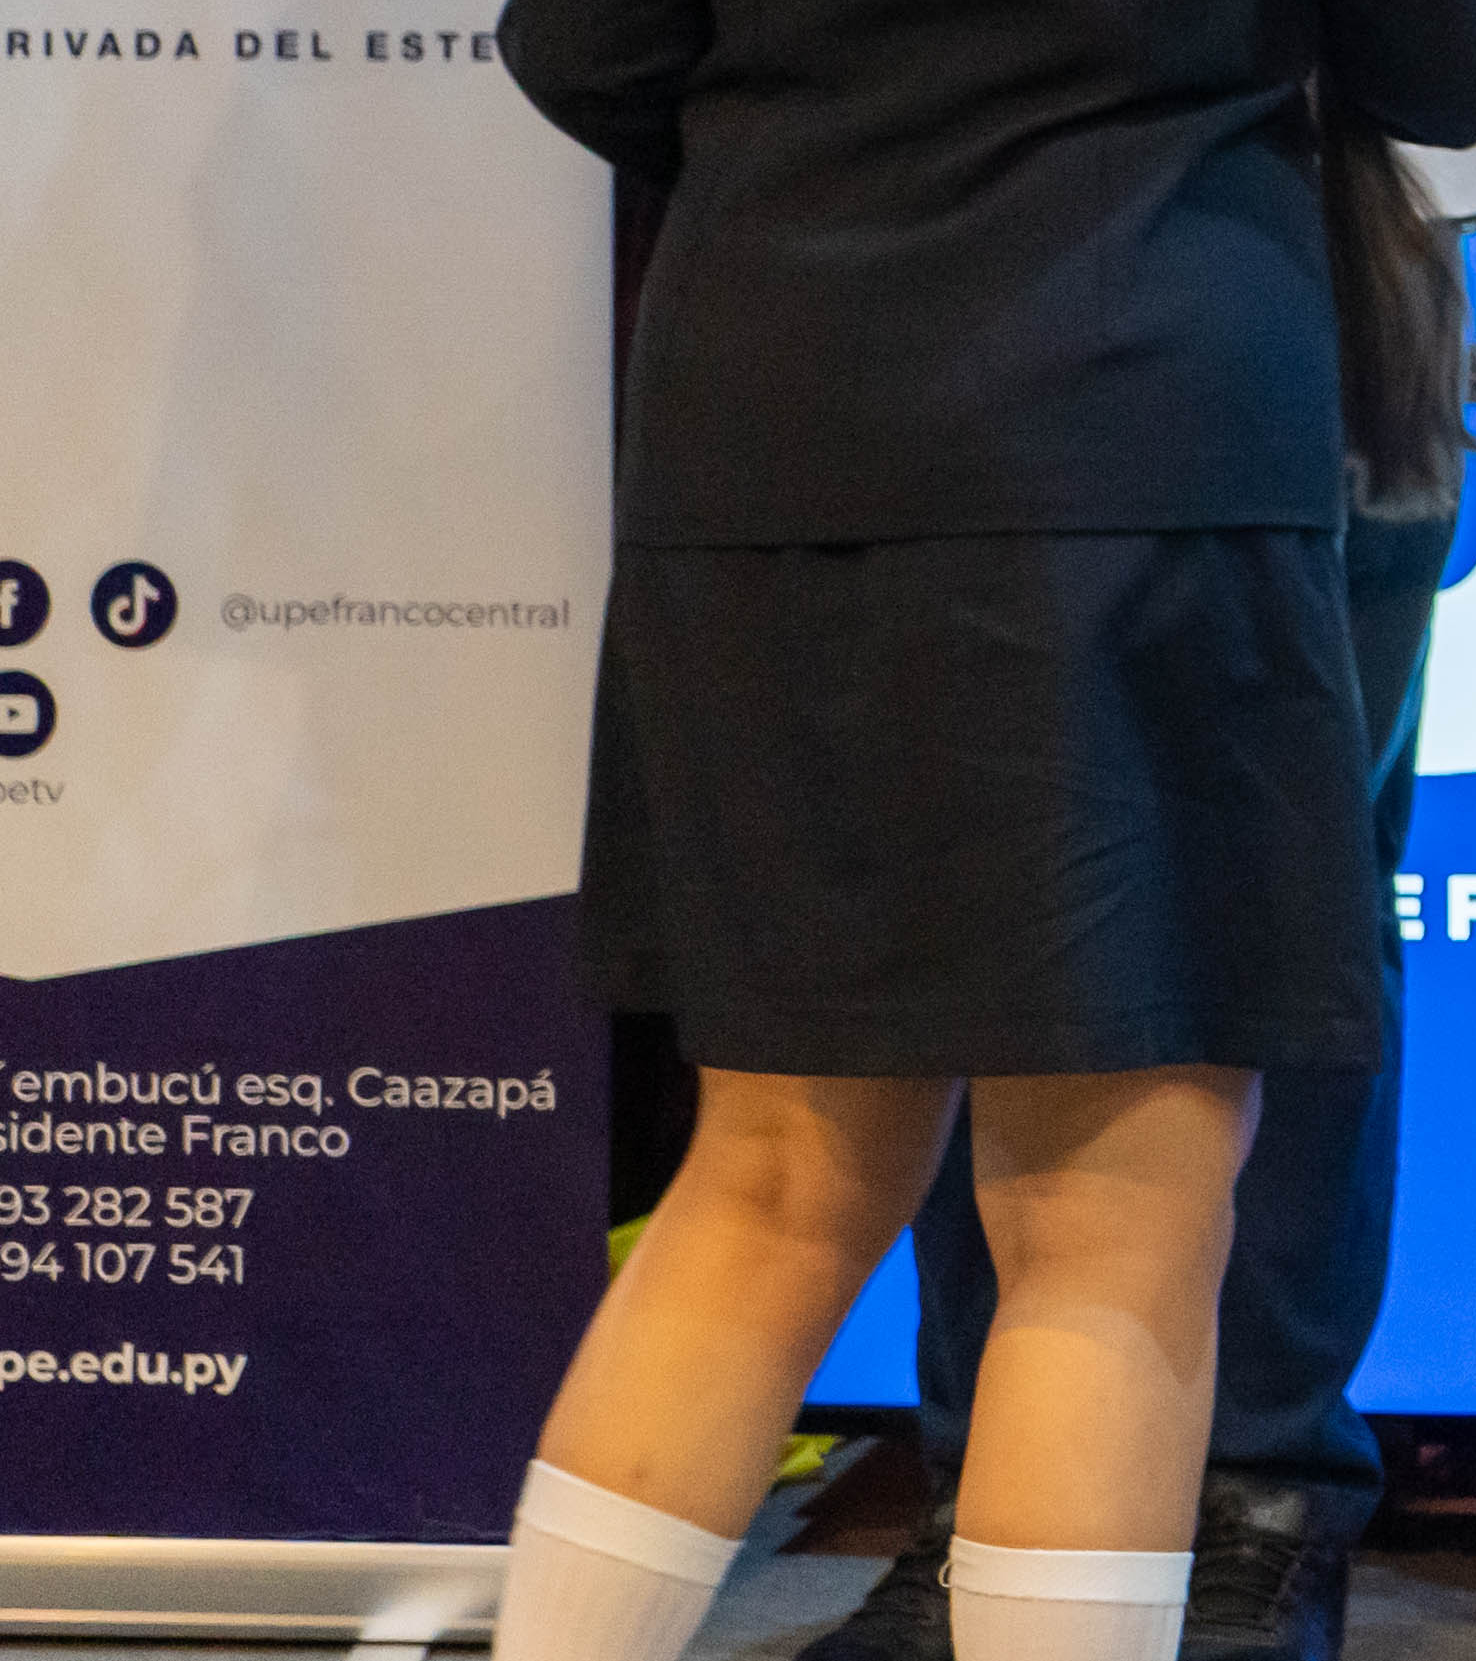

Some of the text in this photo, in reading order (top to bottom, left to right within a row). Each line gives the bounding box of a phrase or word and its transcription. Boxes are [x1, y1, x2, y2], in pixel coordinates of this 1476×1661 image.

[6, 29, 494, 62] RIVADA DEL ESTE
[220, 592, 572, 632] @upefrancocentral
[235, 1073, 334, 1116] esq.
[347, 1066, 557, 1120] Caazapá
[182, 1114, 351, 1158] Franco
[63, 1185, 152, 1227] 282
[164, 1186, 254, 1229] 587
[74, 1242, 157, 1284] 107
[167, 1243, 245, 1285] 541
